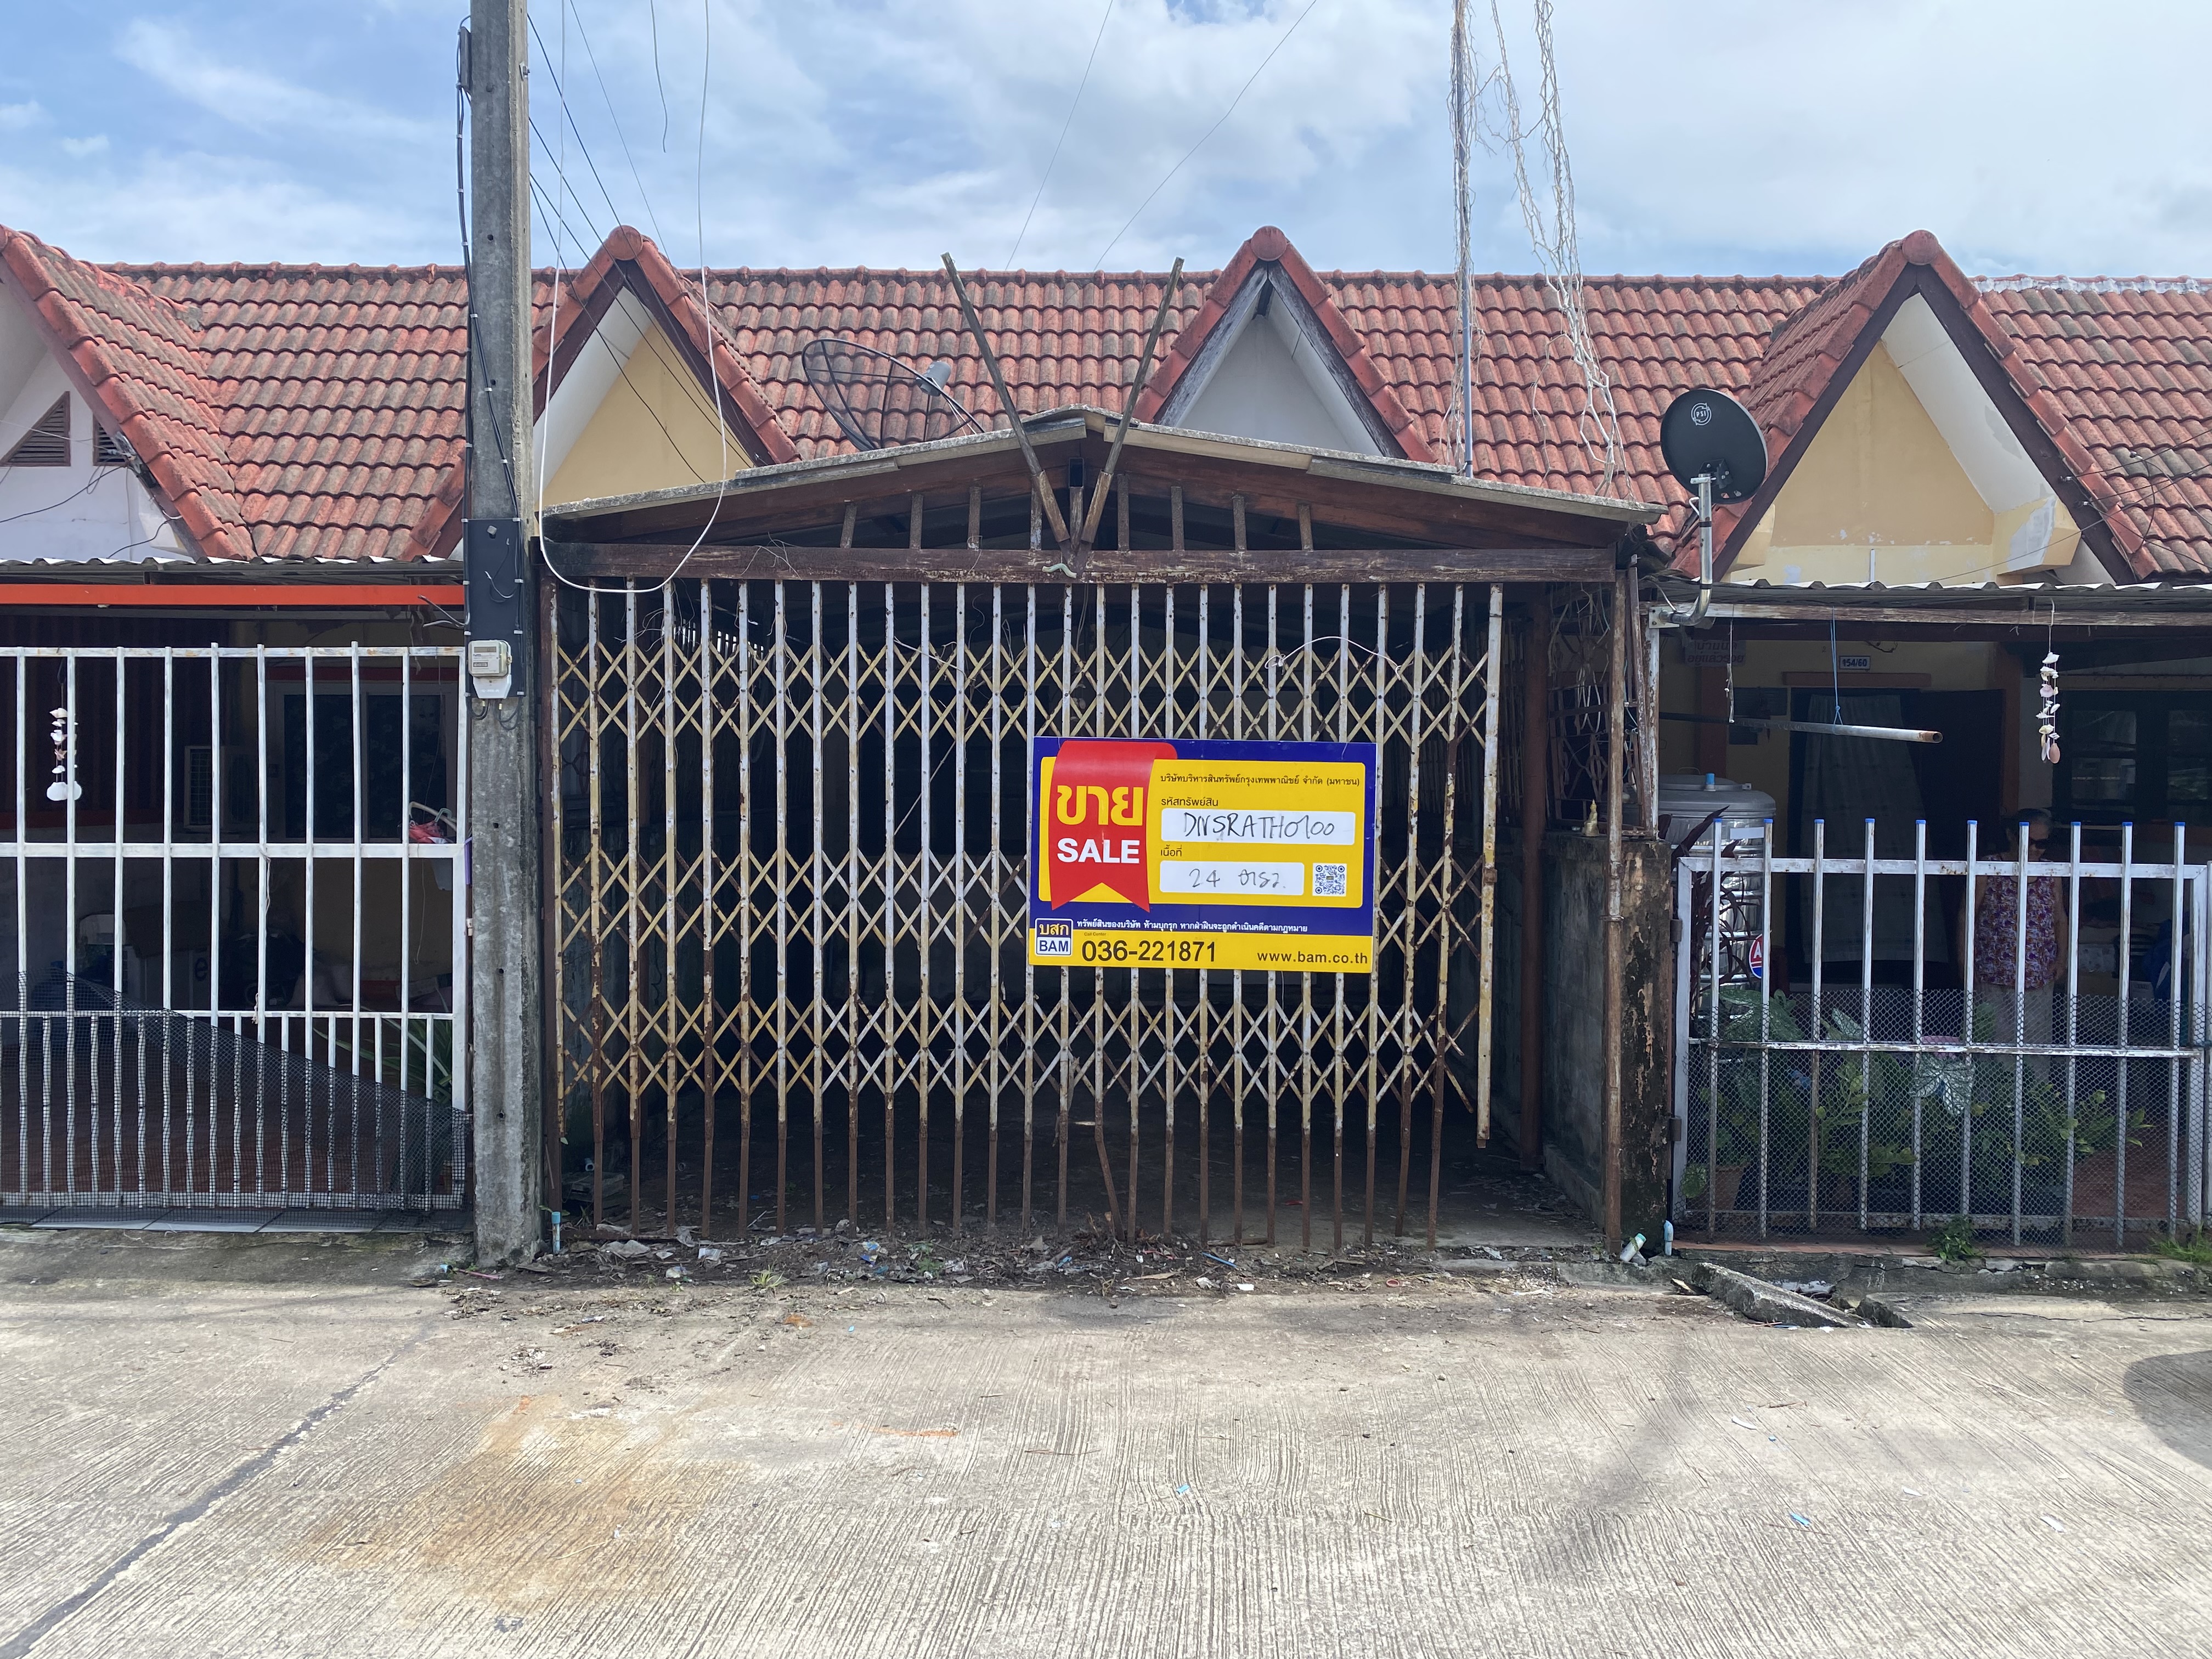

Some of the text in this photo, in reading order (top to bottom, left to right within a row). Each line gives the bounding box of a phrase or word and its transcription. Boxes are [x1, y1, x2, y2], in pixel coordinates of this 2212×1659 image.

[1842, 658, 1867, 667] 154/60
[1160, 773, 1360, 787] บริษัทบริหารสินทรัพย์กรุงเทพพาณิชย์ จำกัด (มหาชน)
[1057, 785, 1144, 826] ขาย
[1160, 796, 1218, 807] รหัสทรัพย์สิน
[1057, 838, 1140, 864] SALE
[1160, 844, 1182, 857] เนื้อที่
[1189, 868, 1221, 888] 24
[1039, 923, 1069, 936] บสก
[1077, 918, 1308, 934] ทรัพย์สินของบริษัท ห้ามบุกรุก หากฝ่าฝืนจะถูกดำเนินคดีตามกฎหมาย
[1039, 940, 1069, 952] BAM
[1082, 940, 1215, 962] 036-221871
[1257, 951, 1368, 964] www.bam.co.th
